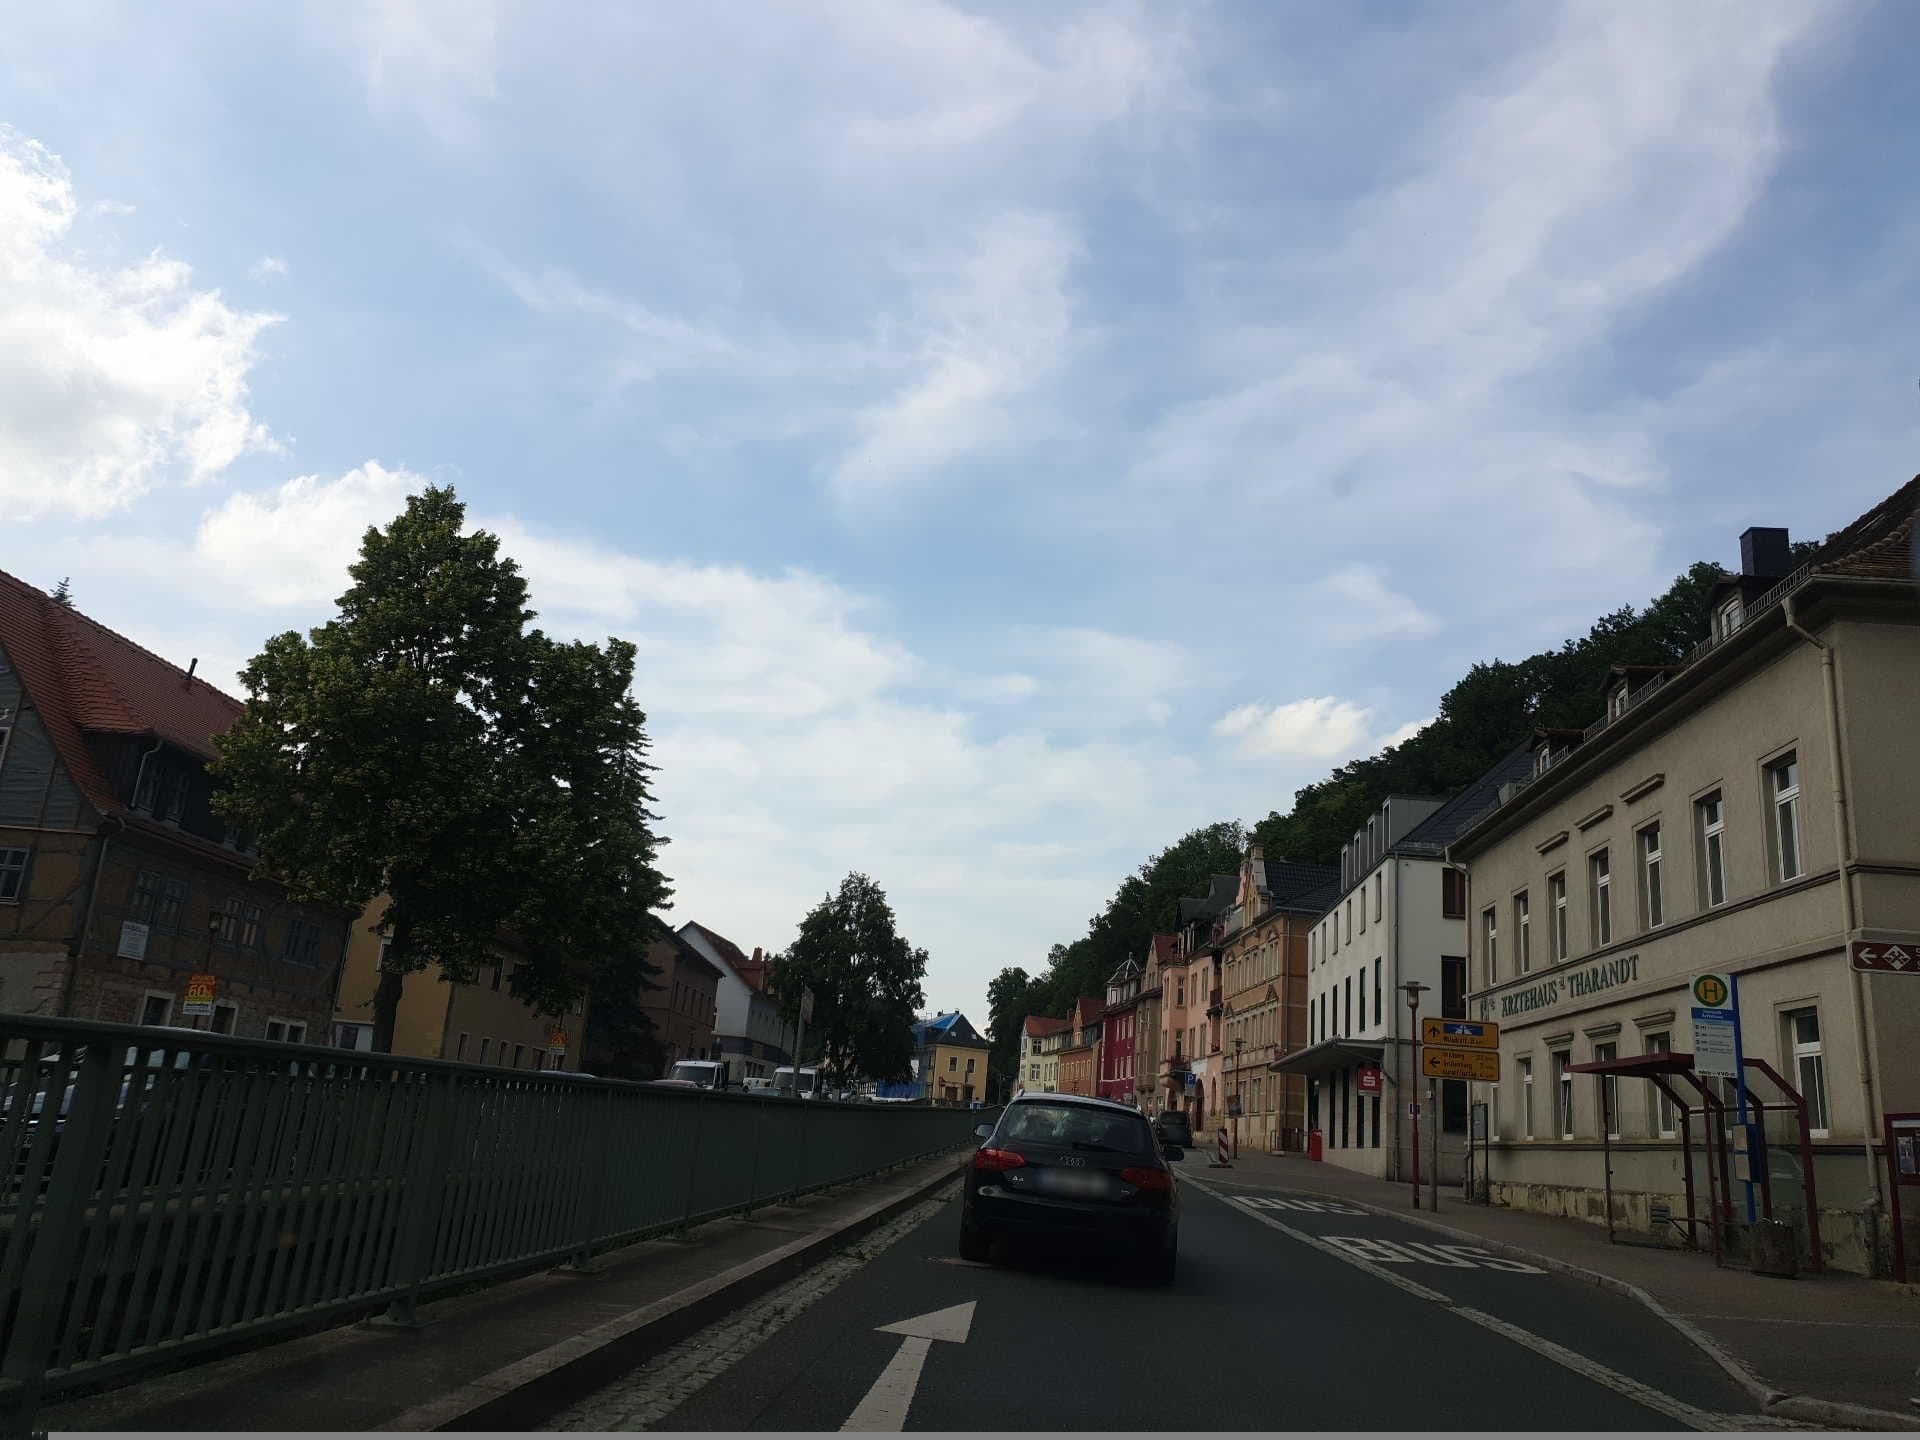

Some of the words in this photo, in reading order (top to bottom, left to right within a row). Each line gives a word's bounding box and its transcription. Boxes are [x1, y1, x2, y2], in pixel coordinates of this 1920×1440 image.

[1567, 954, 1639, 998] THARANDT
[1703, 982, 1718, 1001] H
[1233, 1196, 1369, 1216] BUS
[1319, 1236, 1549, 1274] BUS
